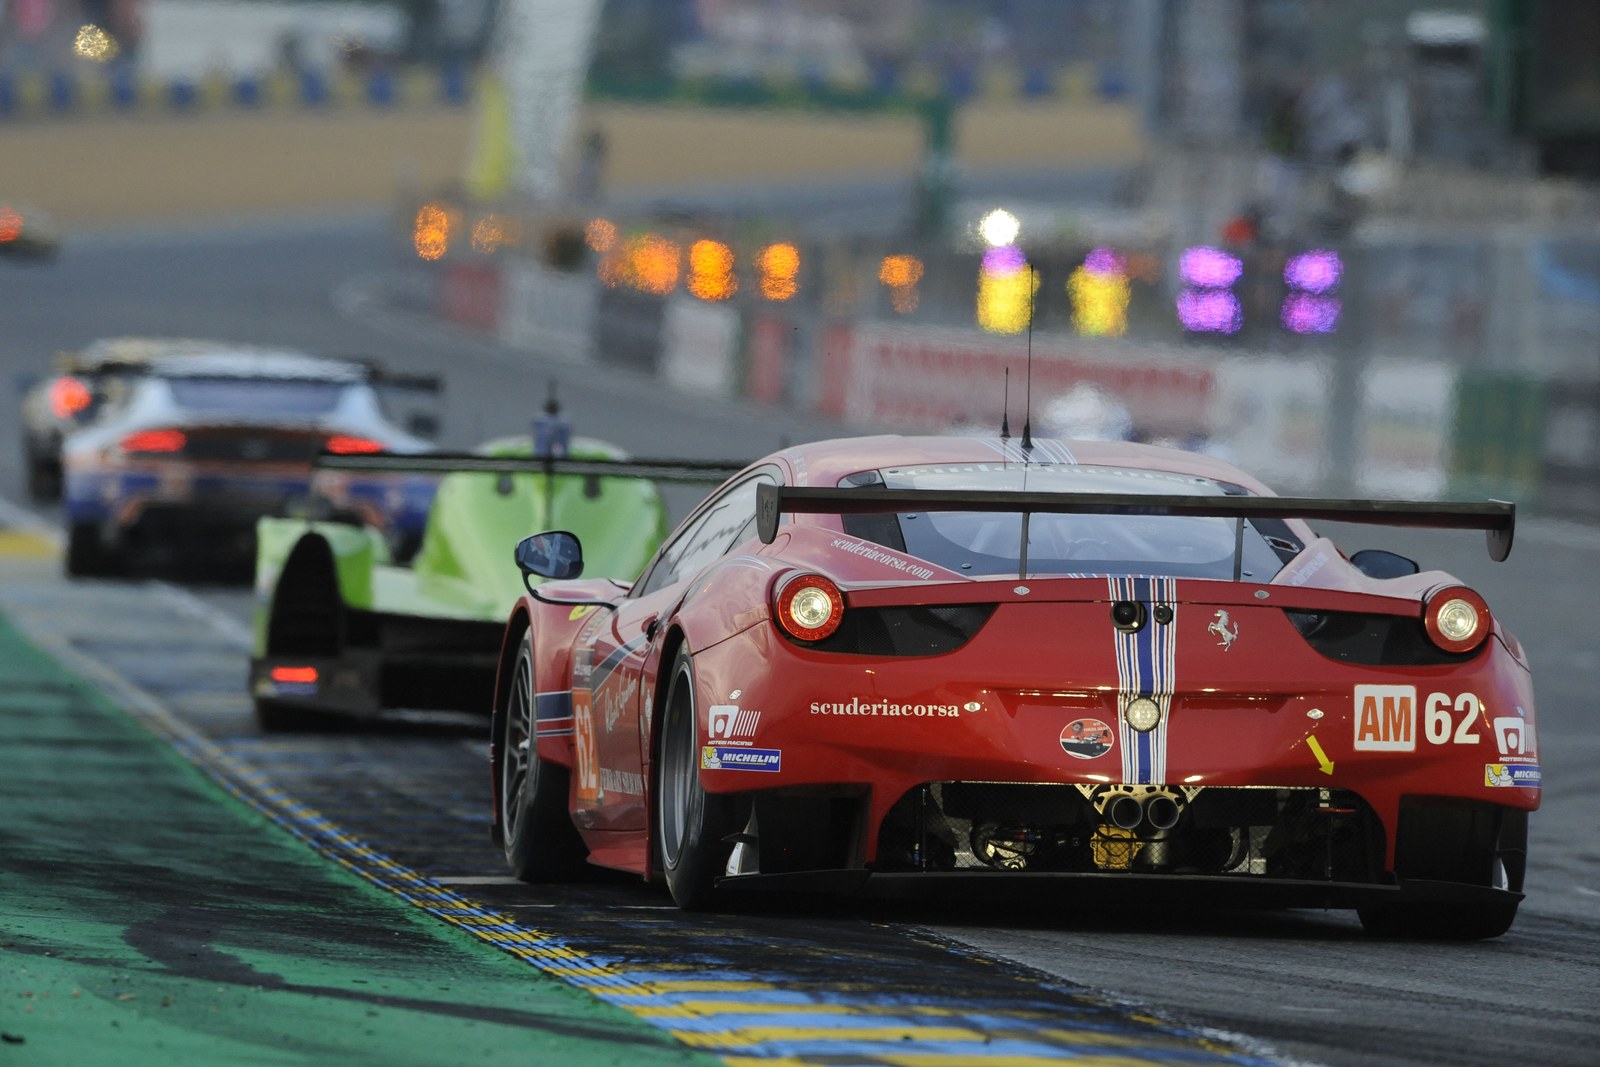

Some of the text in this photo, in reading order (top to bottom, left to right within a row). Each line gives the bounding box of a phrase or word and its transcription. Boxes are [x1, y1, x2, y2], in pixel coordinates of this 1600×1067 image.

[830, 538, 935, 580] scuderiacorsa.com
[810, 697, 960, 717] scuderiacorsa
[1357, 692, 1480, 745] AM 62
[575, 704, 597, 790] 62
[722, 753, 779, 764] MICHELIN
